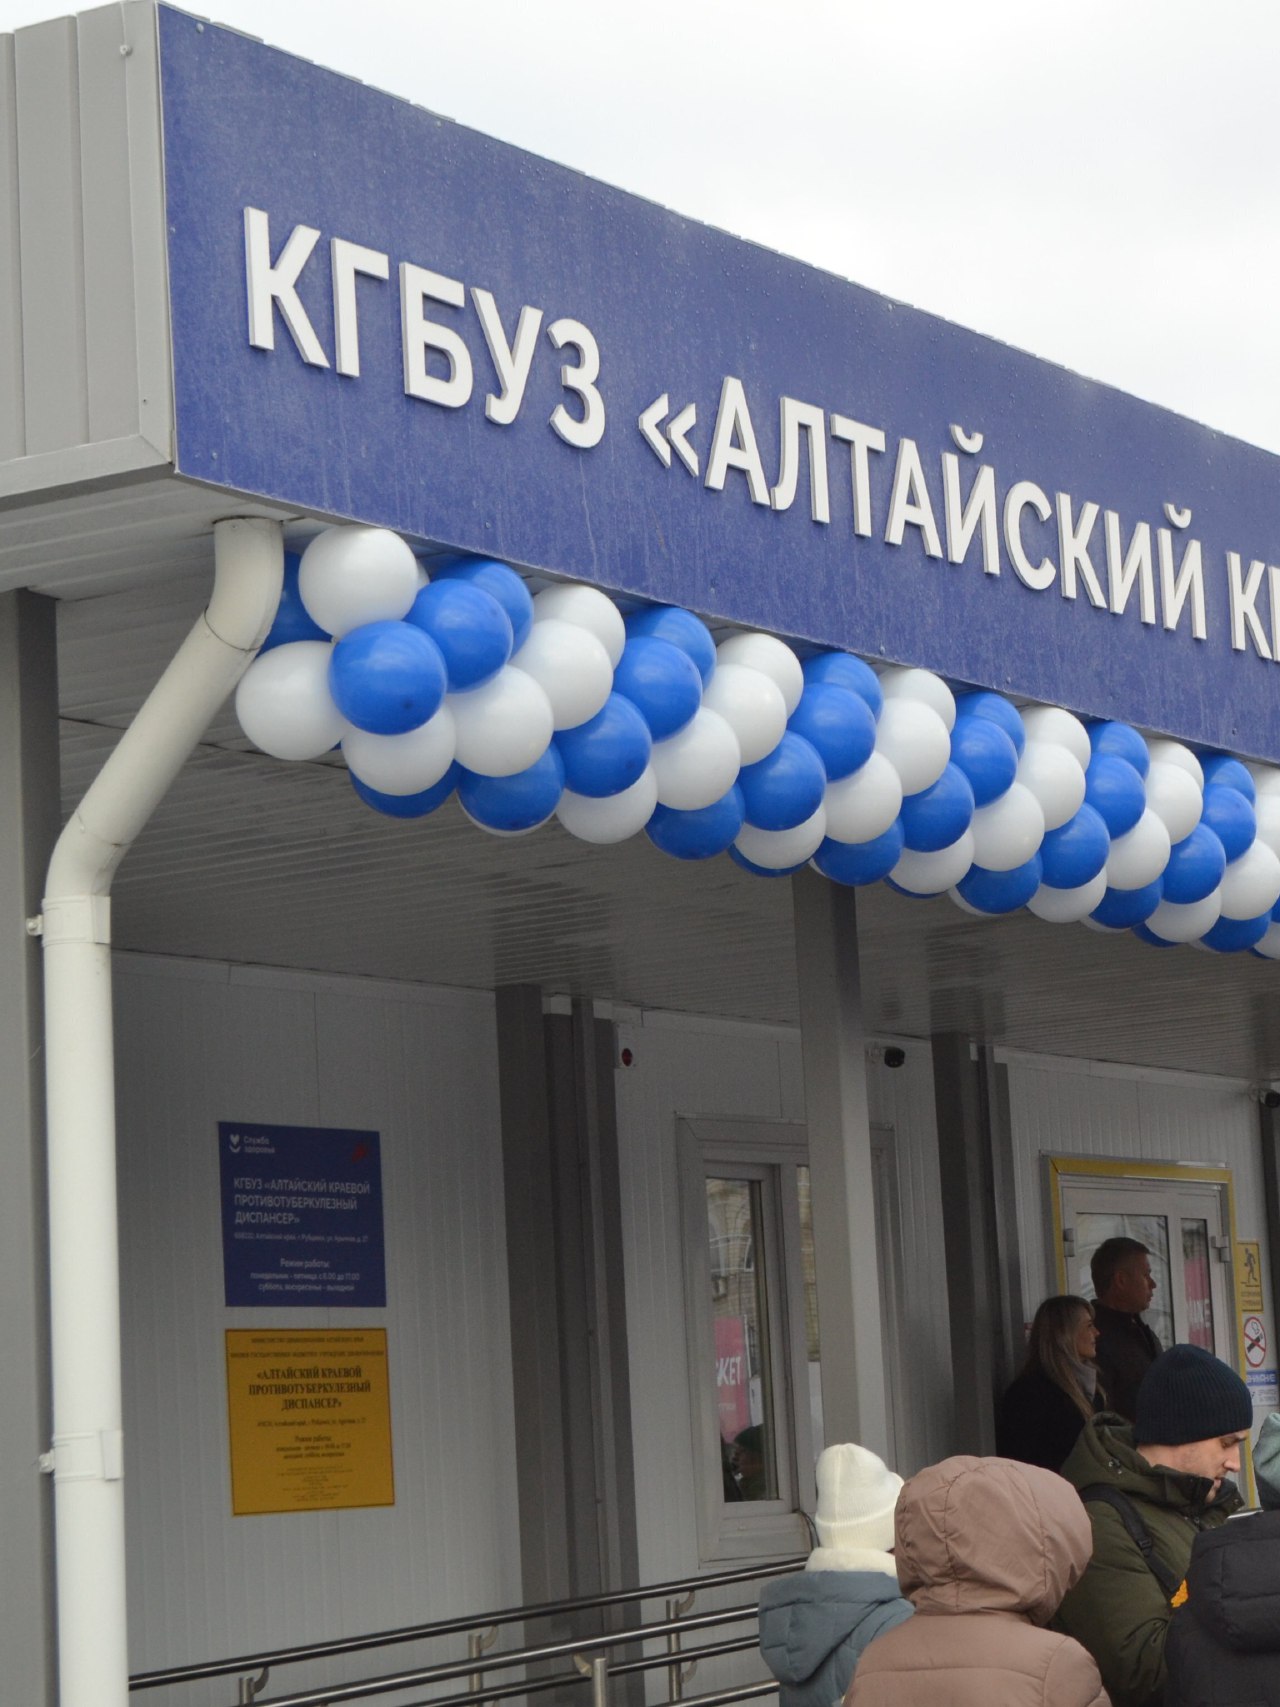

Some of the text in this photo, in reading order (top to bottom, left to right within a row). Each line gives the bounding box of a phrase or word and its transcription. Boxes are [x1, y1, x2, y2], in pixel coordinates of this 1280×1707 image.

[243, 206, 606, 449] КГБУЗ
[638, 375, 1207, 640] «АЛТАЙСКИЙ
[233, 1177, 370, 1194] КГБУЗ «АЛТАЙСКИЙ КРАЕВОЙ
[234, 1194, 358, 1210] ПРОТИВОТУБЕРКУЛЕЗНЫЙ
[235, 1210, 300, 1225] ДИСПАНСЕР»
[320, 1365, 362, 1378] КРАЕВОЙ
[249, 1380, 371, 1396] ПРОТИВОТУБЕРКУЛЕЗНЫЙ
